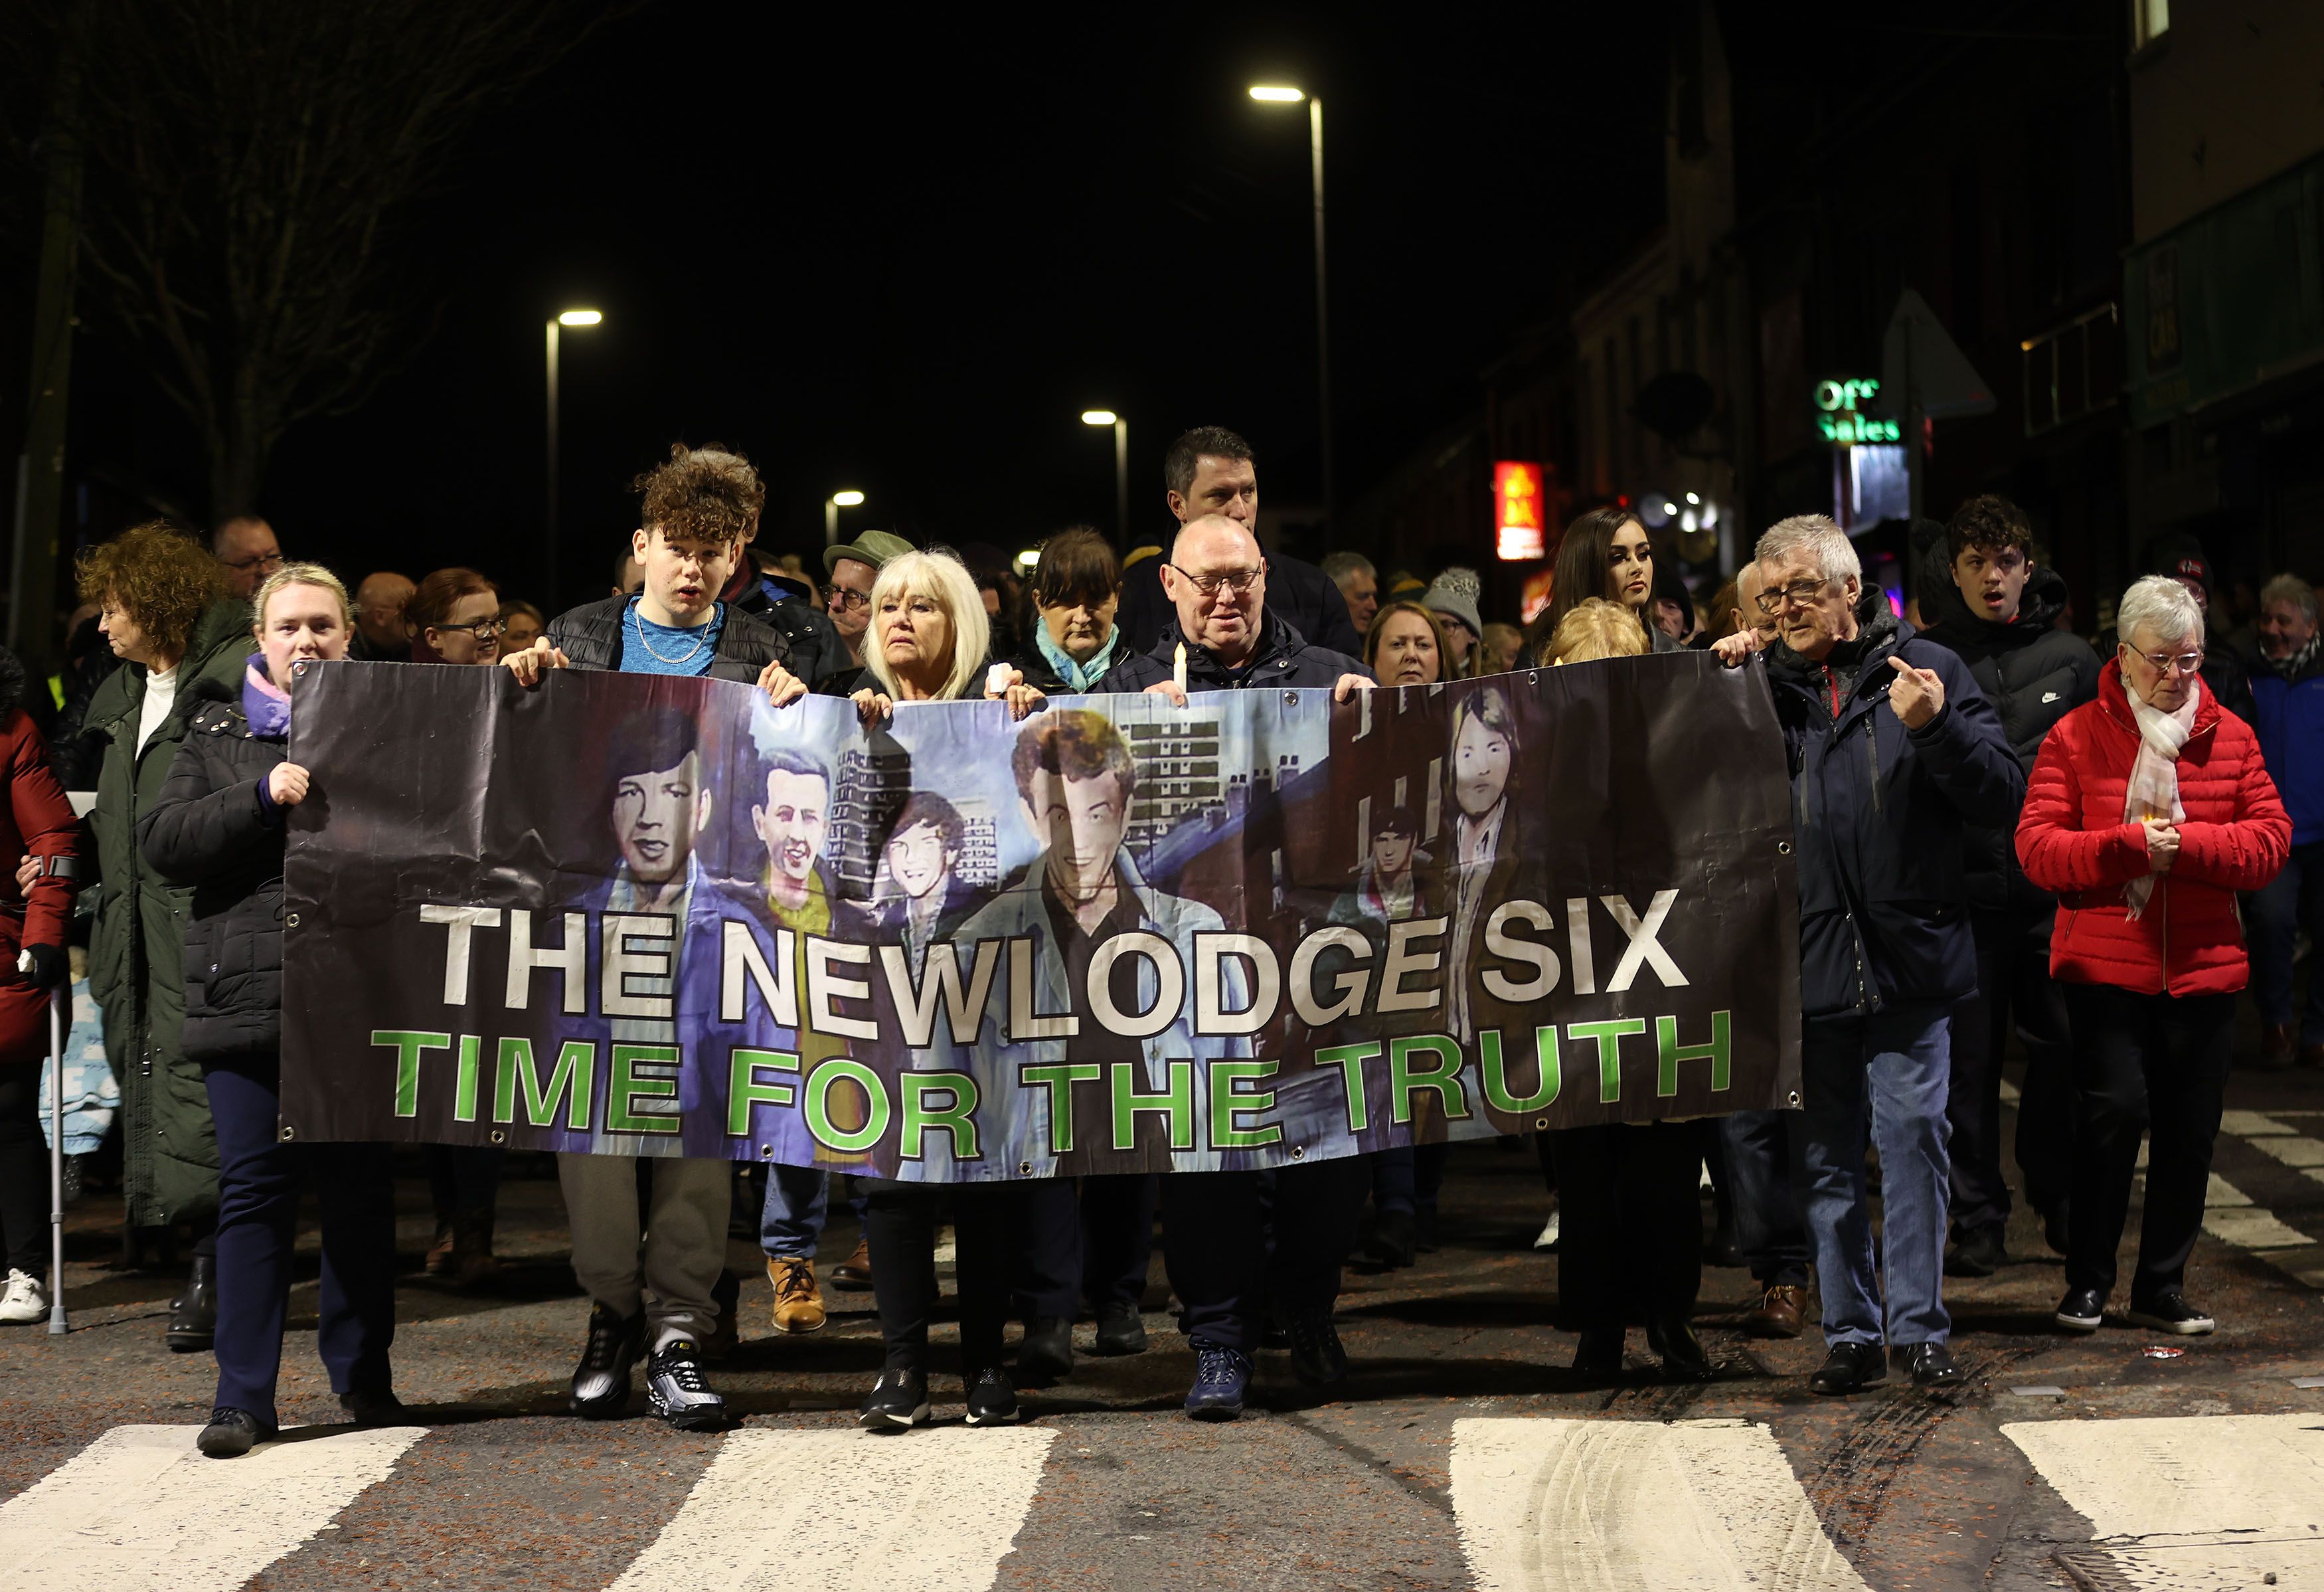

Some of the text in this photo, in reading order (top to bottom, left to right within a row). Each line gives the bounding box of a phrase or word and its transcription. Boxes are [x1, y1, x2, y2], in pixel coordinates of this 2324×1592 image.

[1816, 412, 1900, 442] Sales
[420, 904, 673, 1017] THE
[1481, 889, 1690, 1002] SIX
[371, 1010, 1730, 1158] TIME FOR THE TRUTH
